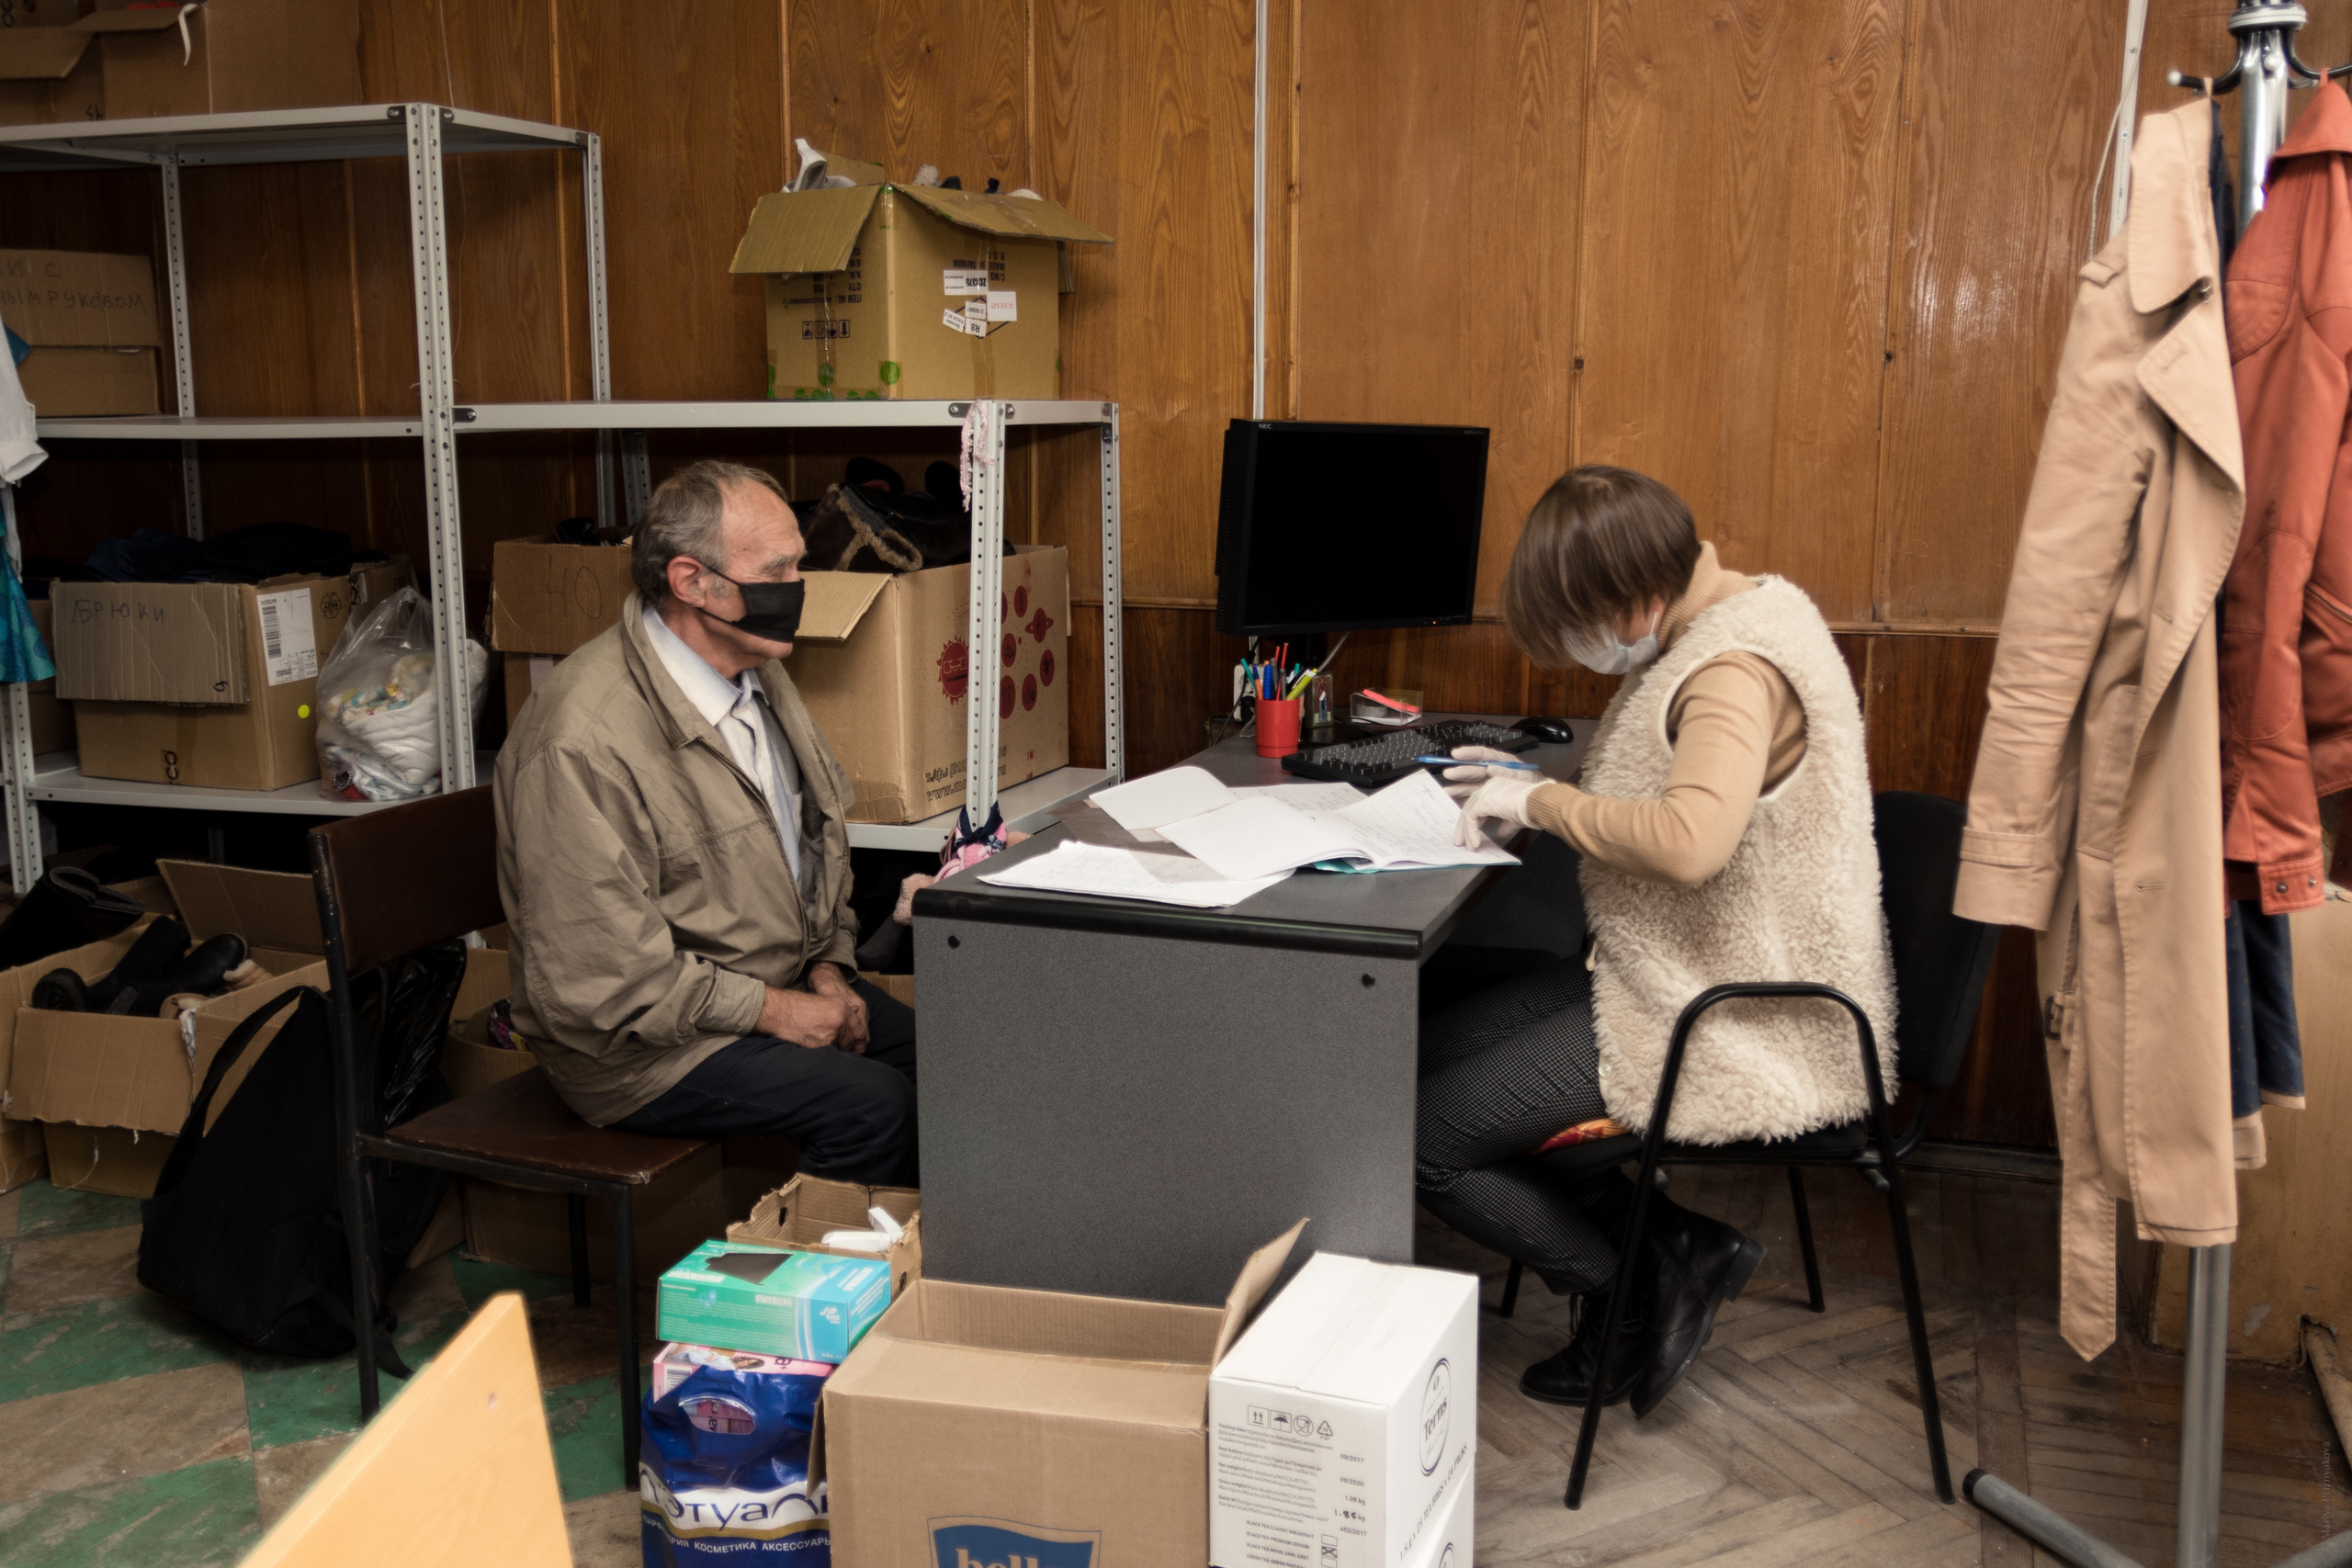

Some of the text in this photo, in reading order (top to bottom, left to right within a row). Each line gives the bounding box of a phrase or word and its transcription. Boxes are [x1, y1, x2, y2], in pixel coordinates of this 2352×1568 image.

[953, 259, 977, 269] TAIWAN
[988, 262, 1005, 271] MADE
[966, 277, 987, 288] ZC1375
[847, 294, 862, 303] ITEM
[970, 323, 980, 333] R8
[70, 599, 164, 624] БРЮКИ
[1340, 1453, 1364, 1463] 09/2017
[1432, 1481, 1443, 1507] BAGS
[1454, 1442, 1467, 1471] PACKS
[1340, 1476, 1364, 1487] 09/2020
[1345, 1495, 1366, 1506] 1.08 kg
[1358, 1514, 1366, 1522] kg
[1246, 1520, 1261, 1529] BLACK
[1271, 1526, 1288, 1534] CLASSIC
[1288, 1529, 1315, 1540] BREAKFAST
[1340, 1527, 1368, 1537] 452/2017
[1246, 1531, 1261, 1540] BLACK
[1270, 1537, 1292, 1546] PREMIUM
[1292, 1540, 1309, 1550] CEYLON
[695, 1541, 758, 1554] КОСМЕТИКА
[1246, 1542, 1261, 1551] BLACK
[1270, 1548, 1285, 1556] ROYAL
[1285, 1551, 1296, 1559] EARL
[1246, 1553, 1261, 1562] GREEN
[1270, 1559, 1285, 1567] GREEN
